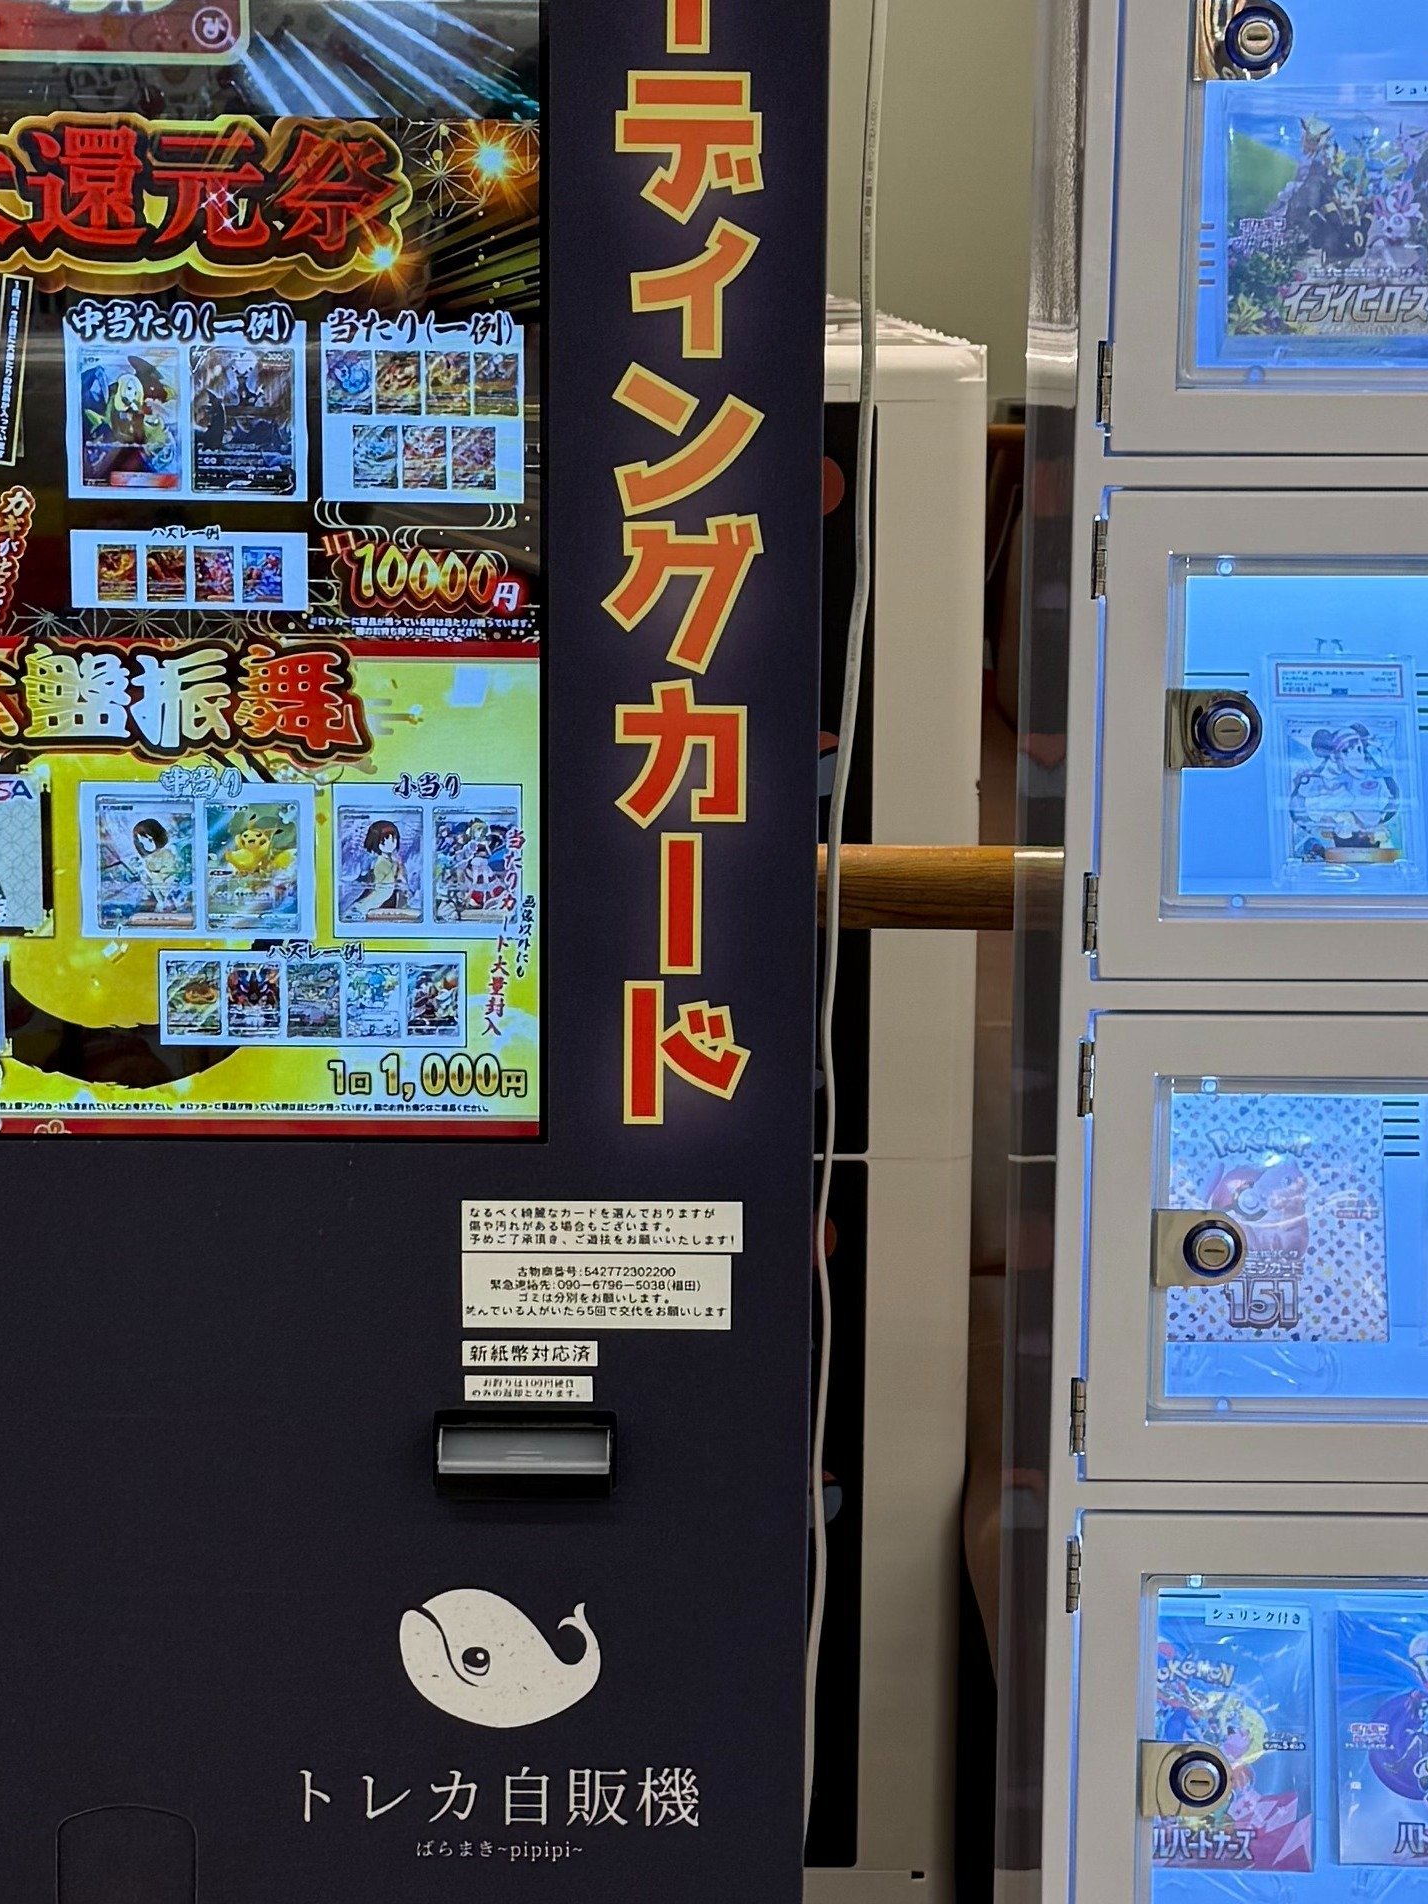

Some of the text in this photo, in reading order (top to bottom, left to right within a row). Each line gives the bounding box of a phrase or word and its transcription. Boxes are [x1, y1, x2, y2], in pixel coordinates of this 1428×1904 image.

[70, 305, 291, 342] 中当たり(一例)
[326, 310, 514, 346] 当たり(一例)
[392, 773, 462, 799] 小当り
[379, 1053, 529, 1100] 1,000円
[518, 1293, 671, 1304] ゴミは分別をお願いします。
[1223, 1276, 1302, 1332] 151
[469, 1344, 591, 1362] 新紙幣対応済
[298, 1766, 701, 1829] トレカ自販機
[416, 1839, 584, 1863] ばらまき~pipipi~
